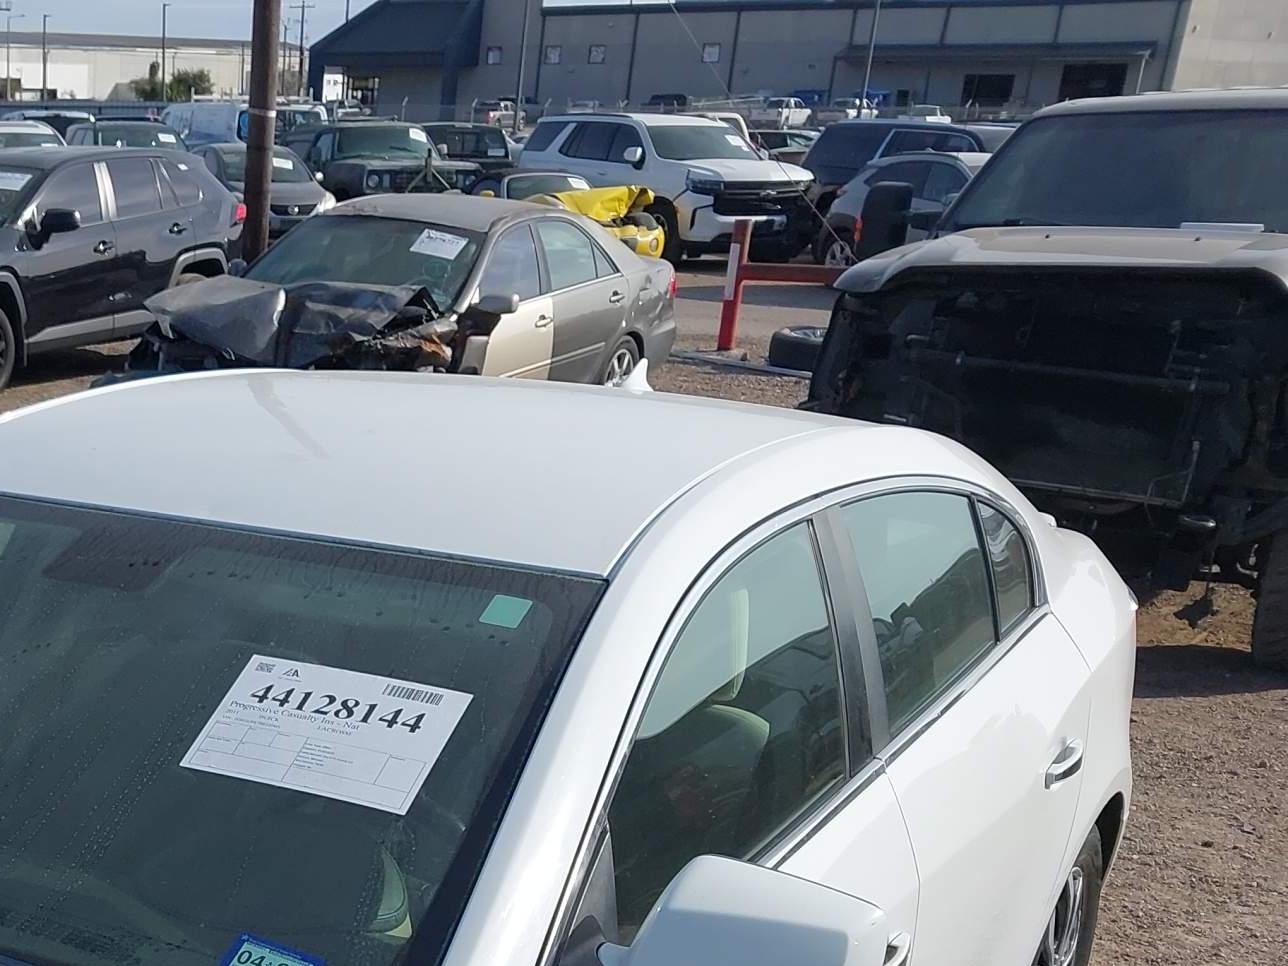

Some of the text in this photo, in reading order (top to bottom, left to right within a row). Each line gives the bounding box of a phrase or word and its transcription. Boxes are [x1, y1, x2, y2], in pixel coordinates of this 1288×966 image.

[230, 700, 280, 716] Progressive
[281, 709, 320, 724] Casualty
[343, 721, 360, 731] Nat
[250, 683, 426, 733] 44128144
